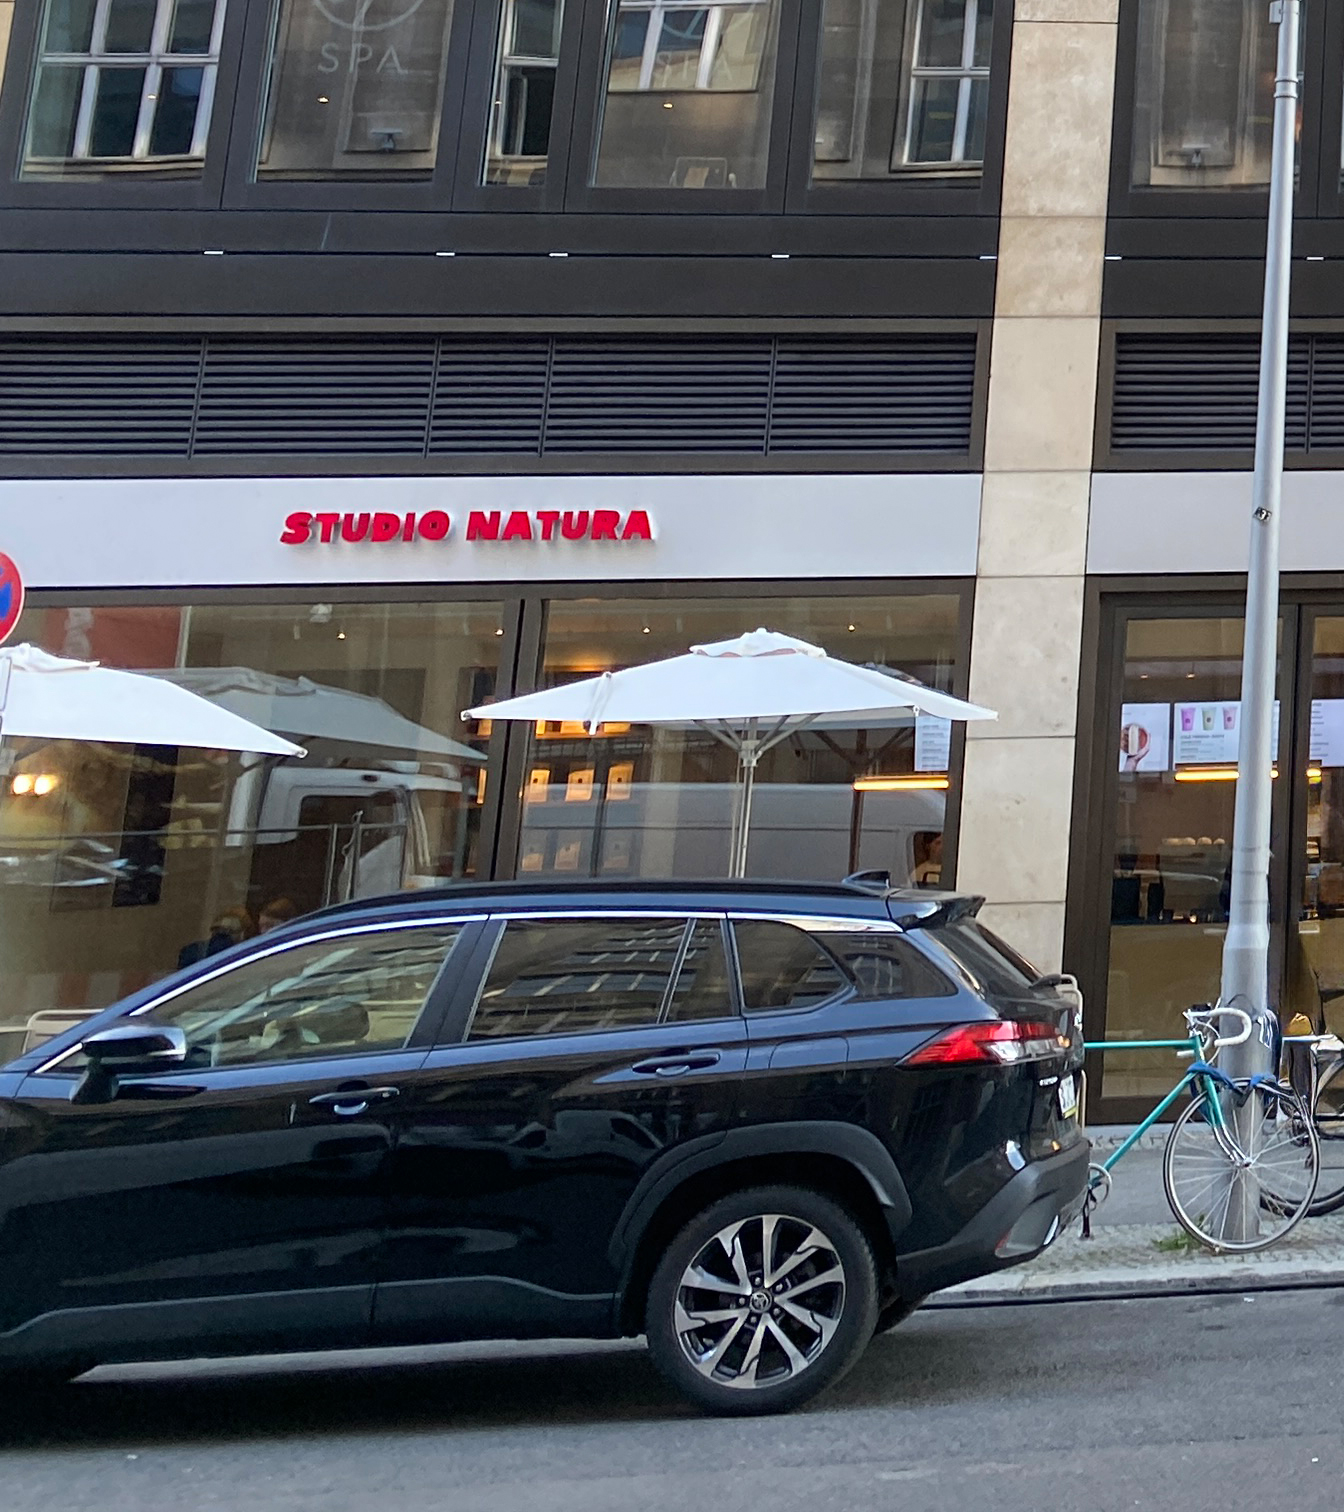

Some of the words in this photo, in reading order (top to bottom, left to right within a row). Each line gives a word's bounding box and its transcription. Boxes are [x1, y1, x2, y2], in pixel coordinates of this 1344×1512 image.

[318, 41, 402, 74] SPA
[280, 510, 451, 544] STUDIO
[466, 510, 652, 541] NATURA
